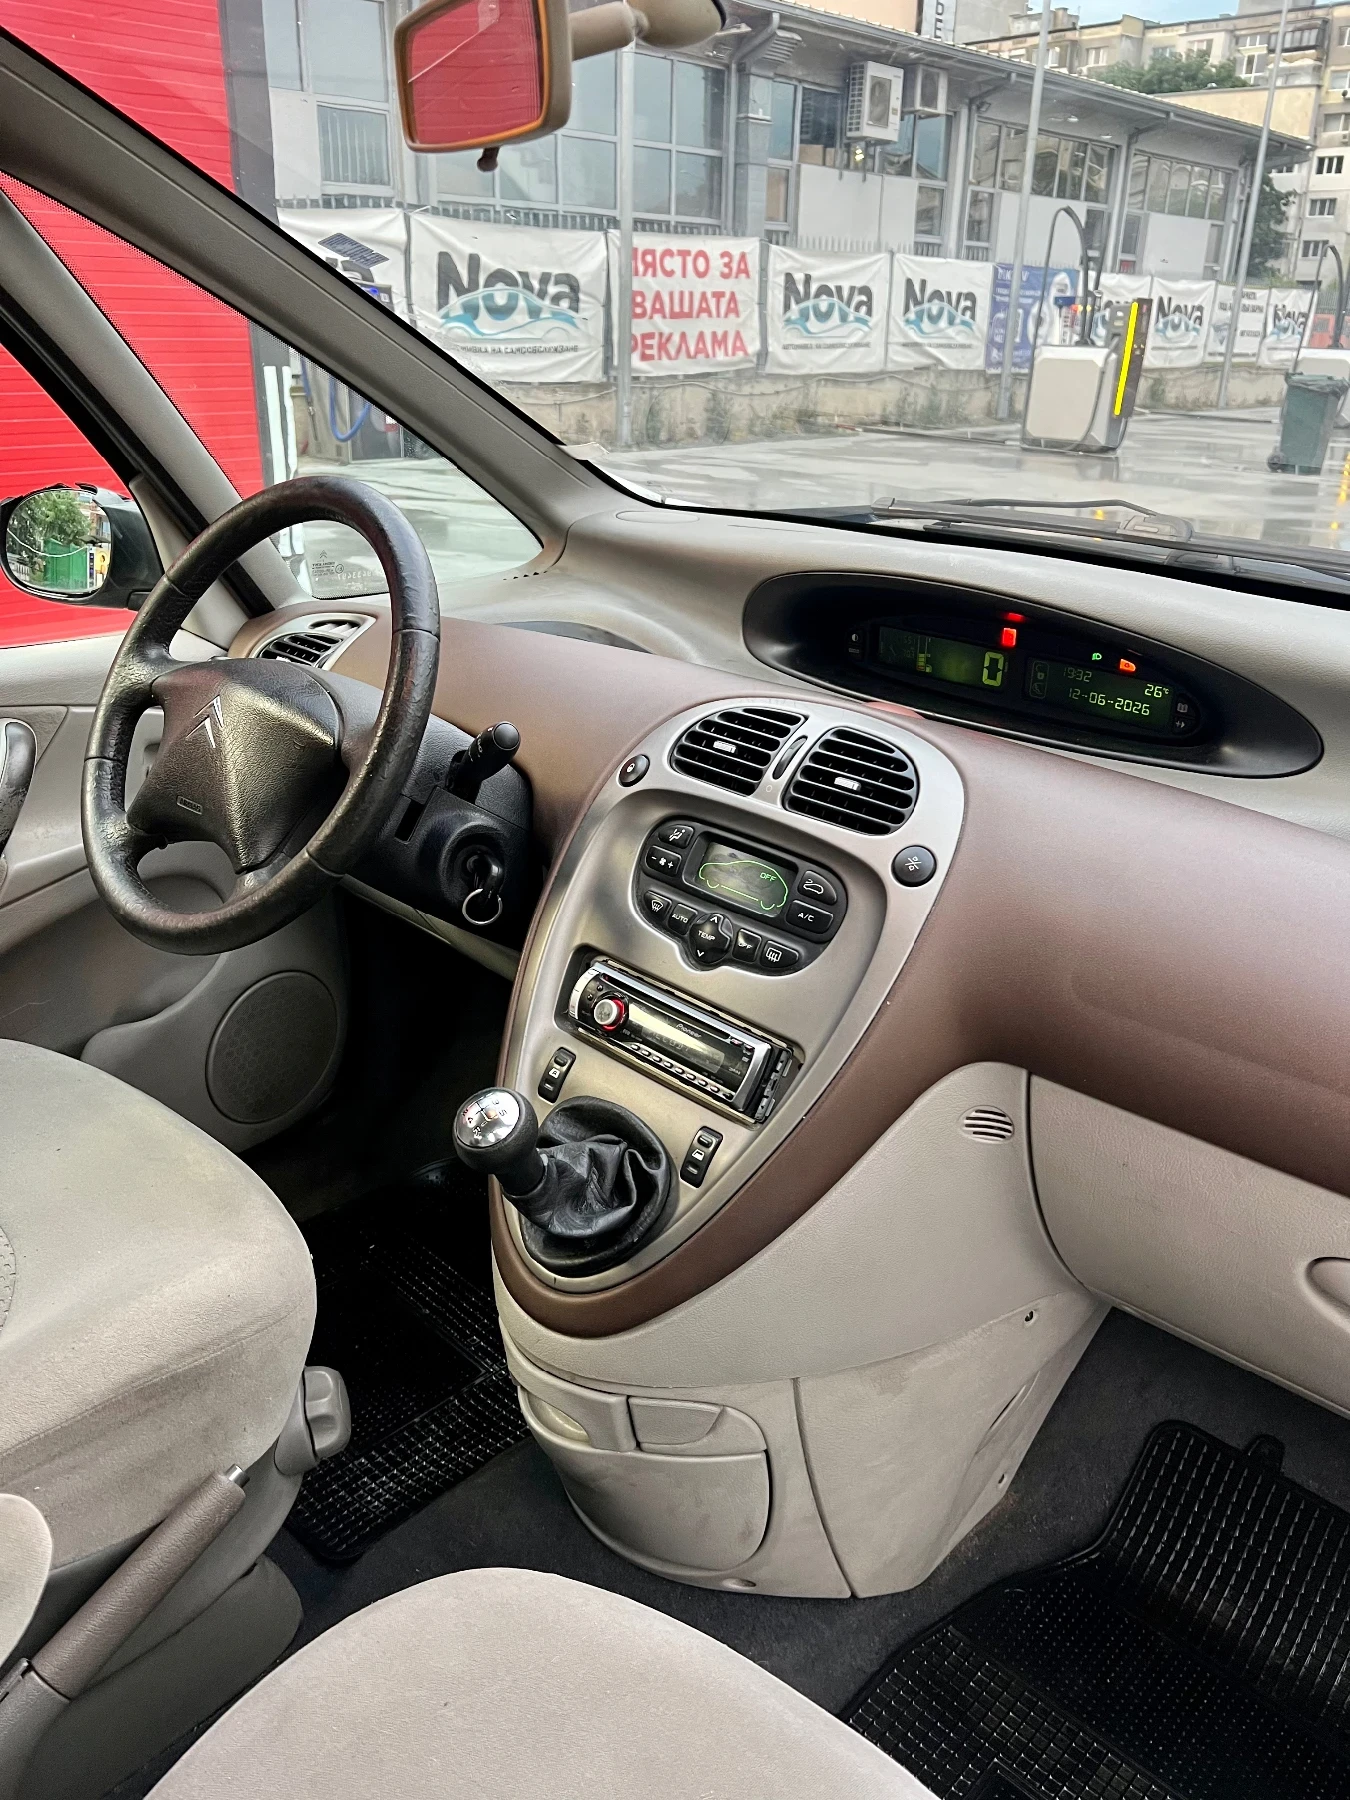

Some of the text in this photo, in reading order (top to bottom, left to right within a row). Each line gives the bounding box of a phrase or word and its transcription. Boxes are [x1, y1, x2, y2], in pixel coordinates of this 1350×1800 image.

[720, 251, 751, 279] ЗА
[437, 251, 580, 321] Nova
[783, 272, 873, 324] Nova
[632, 289, 740, 320] ВАШАТА
[904, 277, 977, 324] Nova
[1154, 295, 1204, 332] Nova
[982, 651, 1004, 687] 0
[1068, 687, 1150, 716] 12-06-2026
[759, 872, 777, 882] OFF
[671, 912, 689, 924] AUTO
[797, 912, 815, 923] A/C
[698, 930, 716, 941] TEMP
[737, 942, 753, 950] OFF
[675, 1023, 702, 1038] Pioneer
